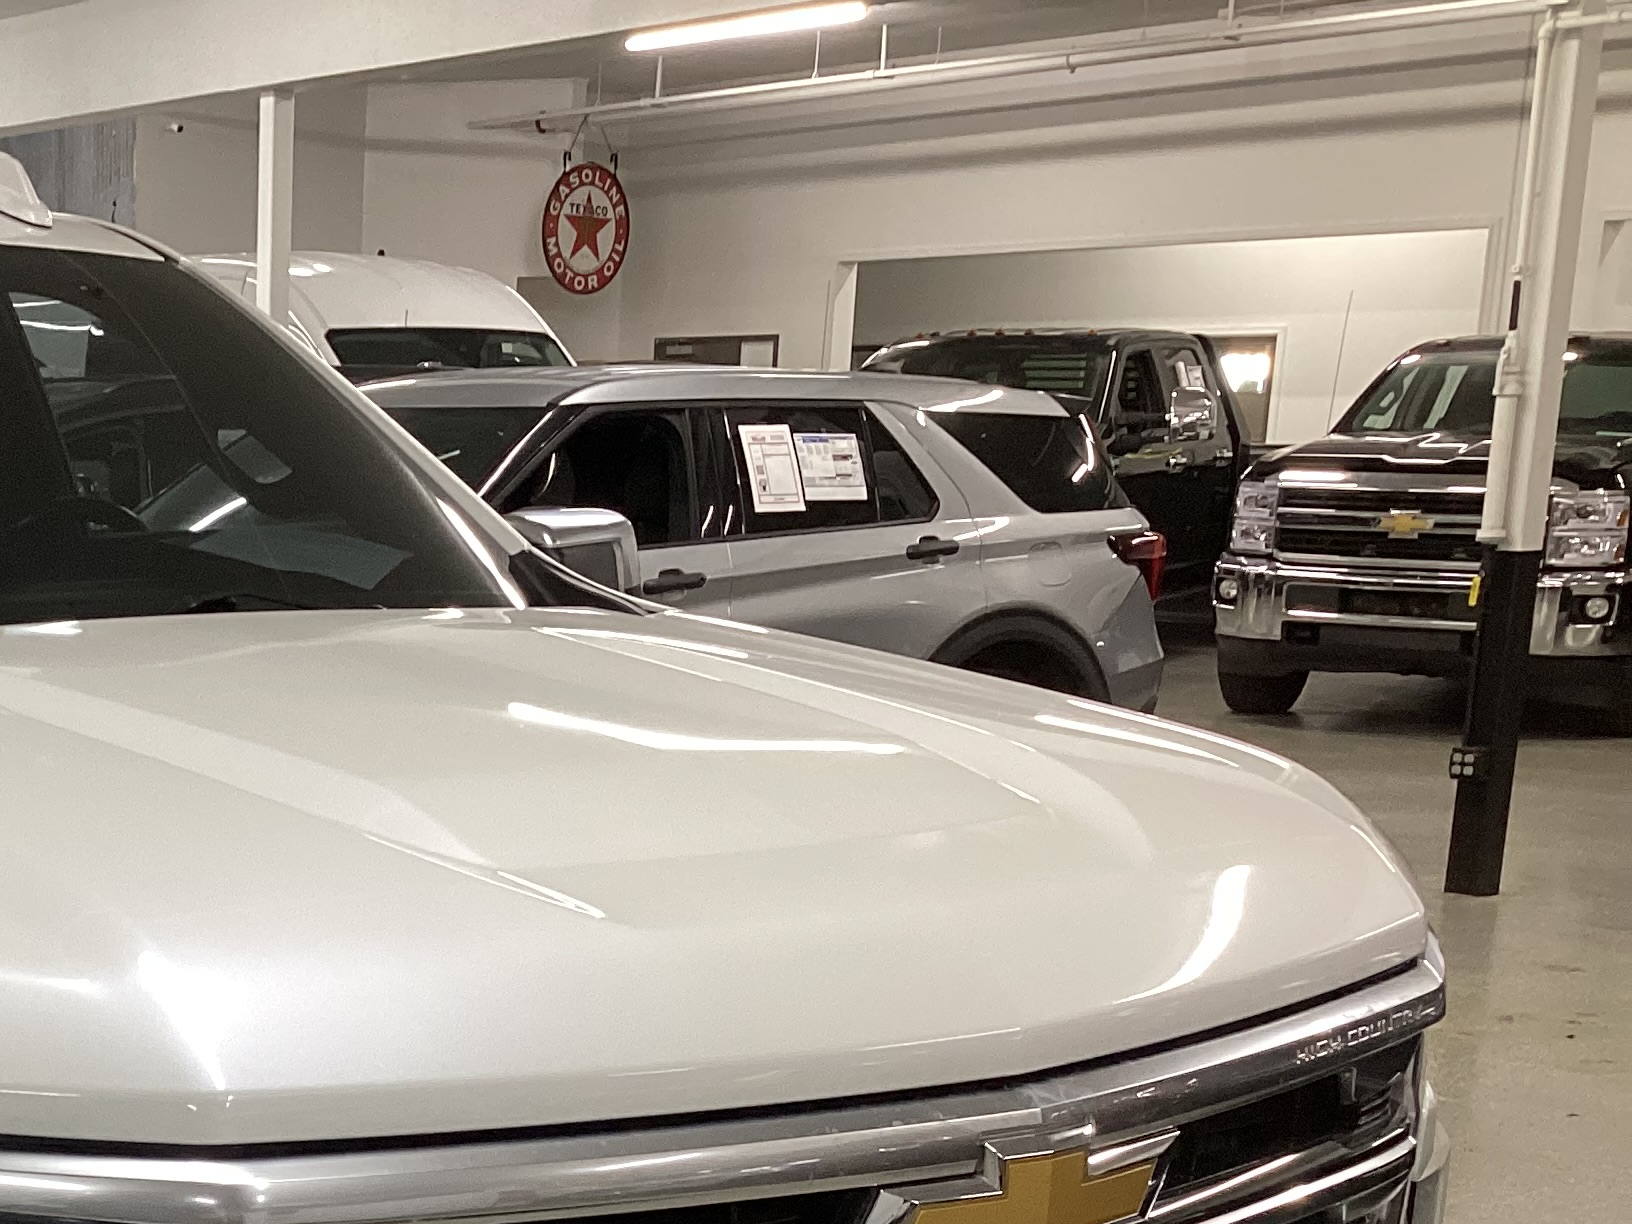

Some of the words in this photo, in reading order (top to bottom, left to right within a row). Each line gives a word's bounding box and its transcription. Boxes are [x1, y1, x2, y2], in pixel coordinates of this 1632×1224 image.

[550, 169, 626, 220] GASOLINE
[547, 236, 598, 291] MOTOR
[603, 239, 625, 276] OIL
